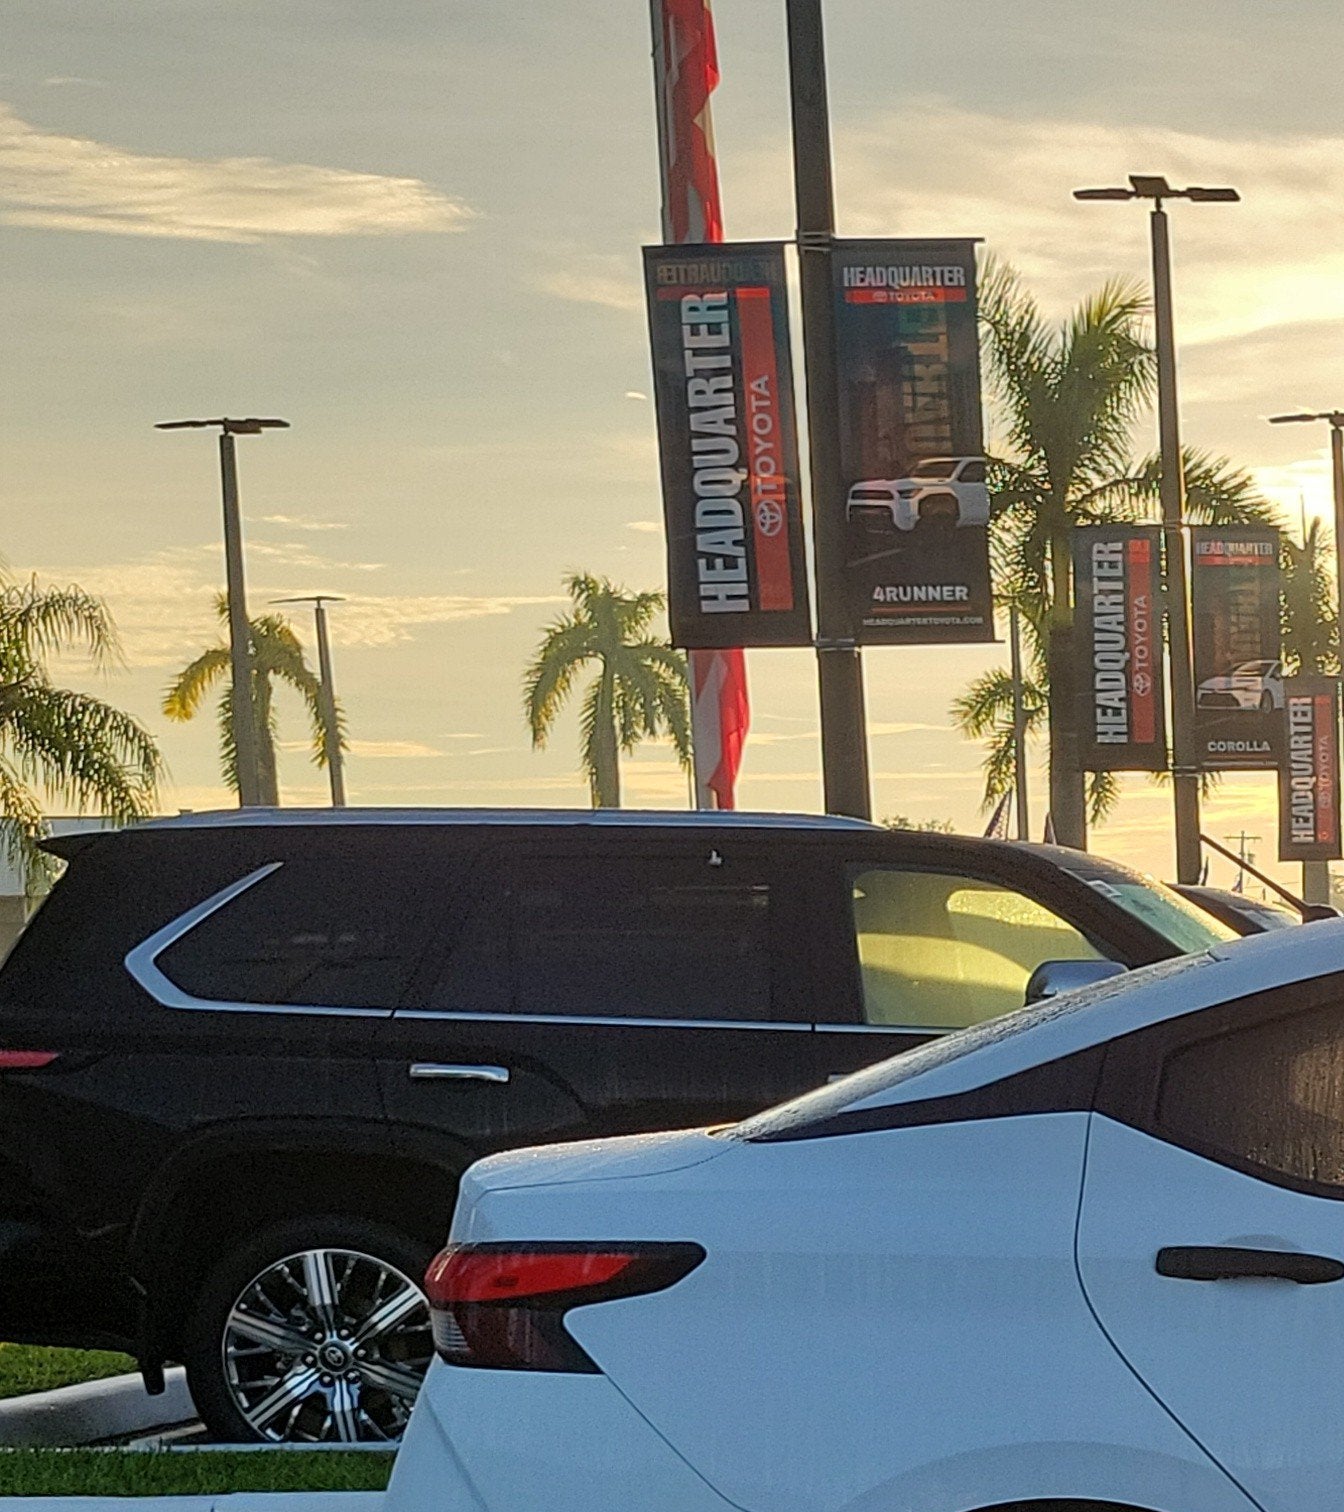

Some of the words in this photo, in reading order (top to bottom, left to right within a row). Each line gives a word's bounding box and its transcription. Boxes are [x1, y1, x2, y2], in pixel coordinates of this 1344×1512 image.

[843, 266, 966, 289] HEADQUARTER
[889, 291, 936, 302] TOYOTA
[681, 290, 750, 614] HEADQUARTER
[750, 374, 779, 497] TOYOTA
[872, 585, 969, 602] 4RUNNER
[1093, 541, 1131, 744] HEADQUARTER
[1133, 595, 1149, 671] TOYOTA
[1207, 741, 1271, 753] COROLLA
[1288, 697, 1316, 844] HEADQUARTER
